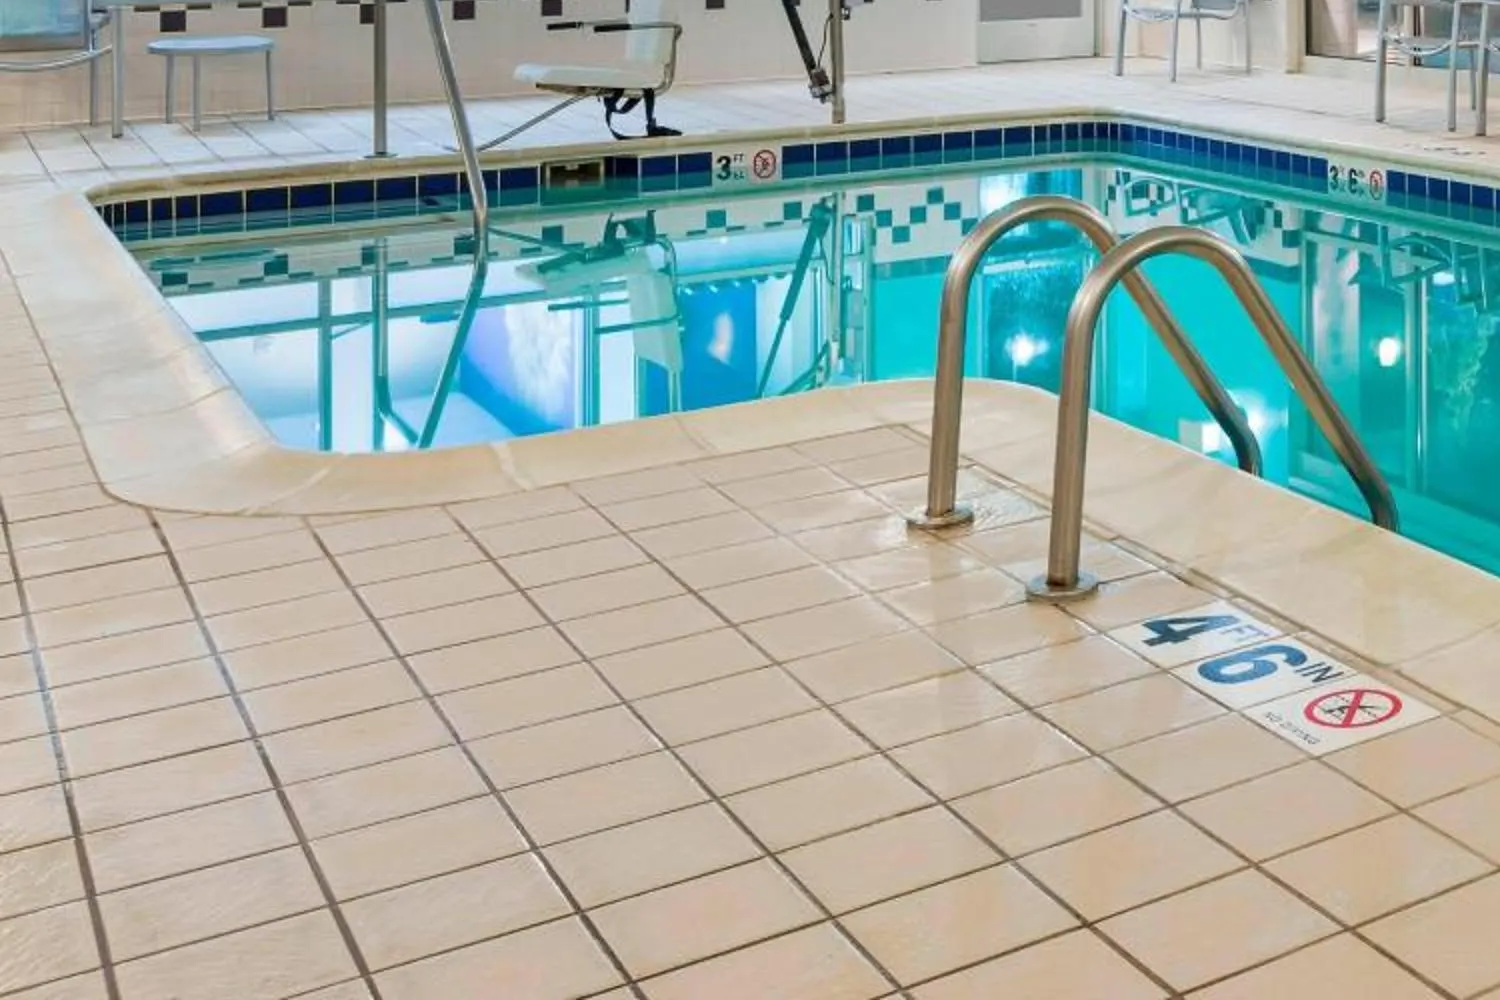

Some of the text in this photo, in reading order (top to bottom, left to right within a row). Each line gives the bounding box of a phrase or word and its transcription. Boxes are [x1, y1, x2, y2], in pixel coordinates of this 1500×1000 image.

[717, 155, 731, 179] 3
[1142, 615, 1344, 685] 4 FT 6 IN
